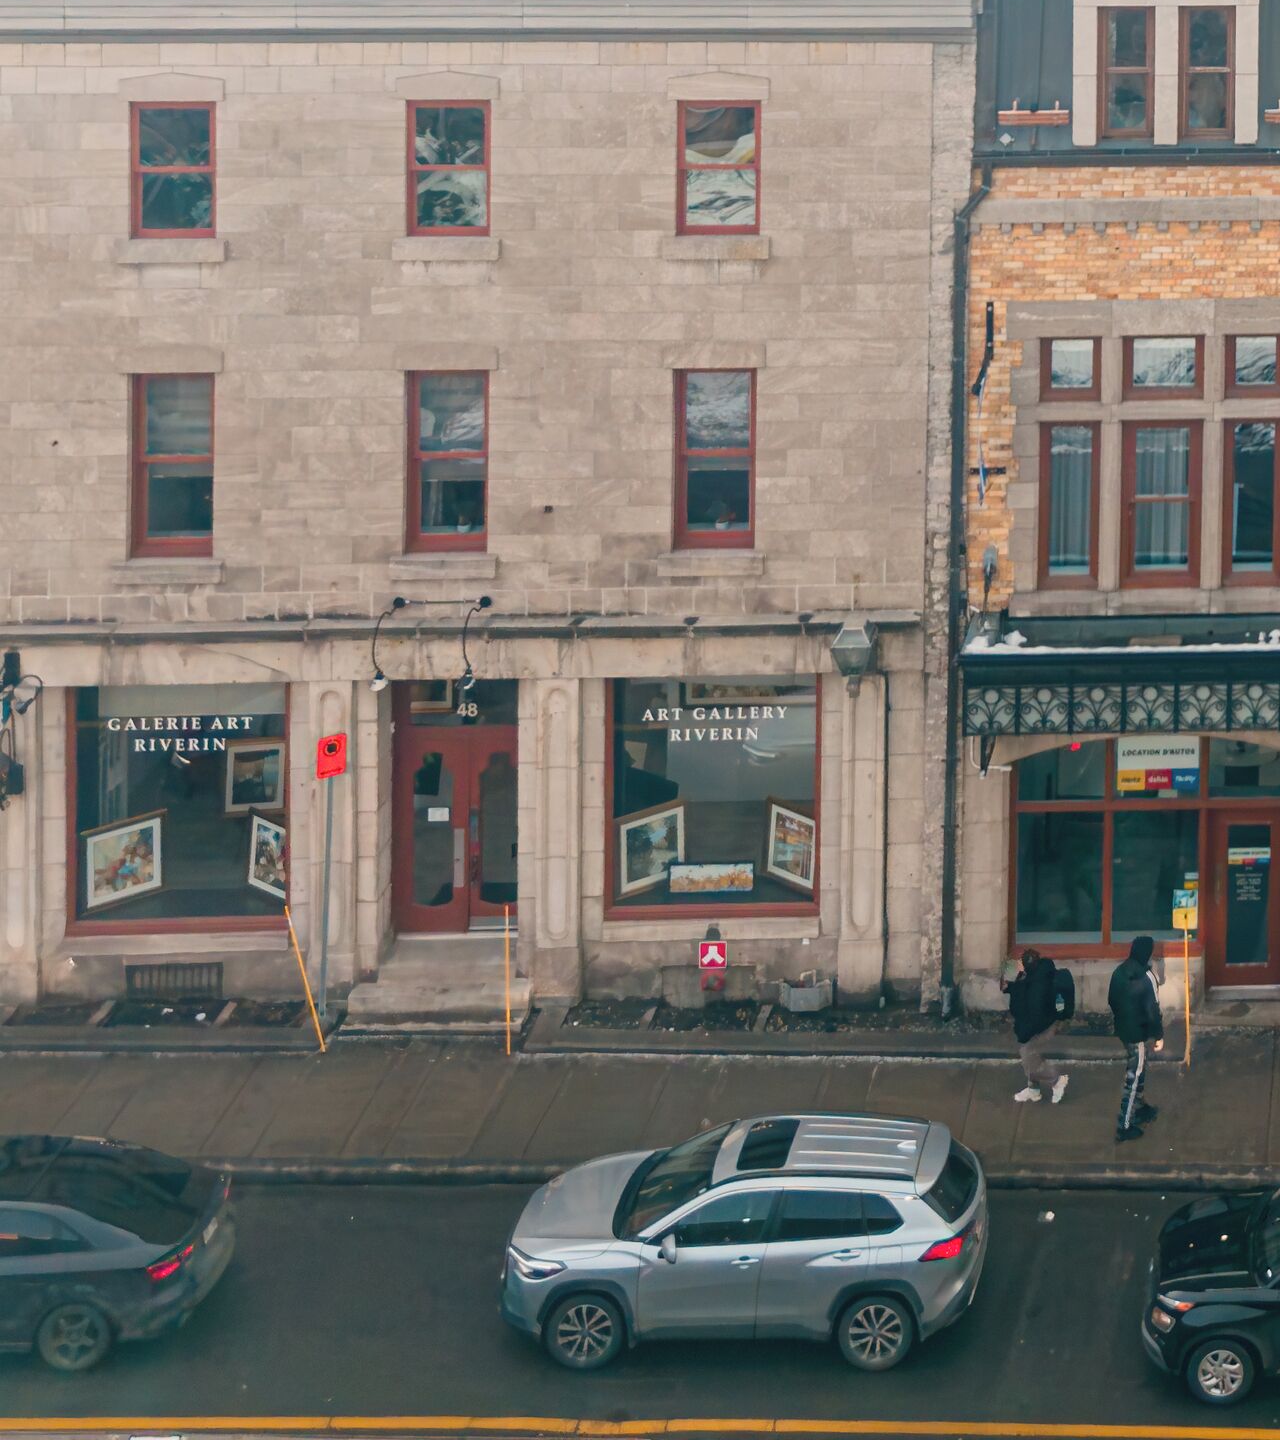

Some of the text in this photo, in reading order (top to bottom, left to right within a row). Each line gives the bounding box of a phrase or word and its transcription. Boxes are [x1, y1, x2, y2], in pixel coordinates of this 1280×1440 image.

[457, 703, 478, 717] 48
[642, 706, 788, 721] ART GALLERY
[107, 717, 253, 731] GALERIE ART
[670, 727, 759, 742] RIVERIN
[134, 737, 226, 752] RIVERIN
[1122, 749, 1160, 757] LOCATION
